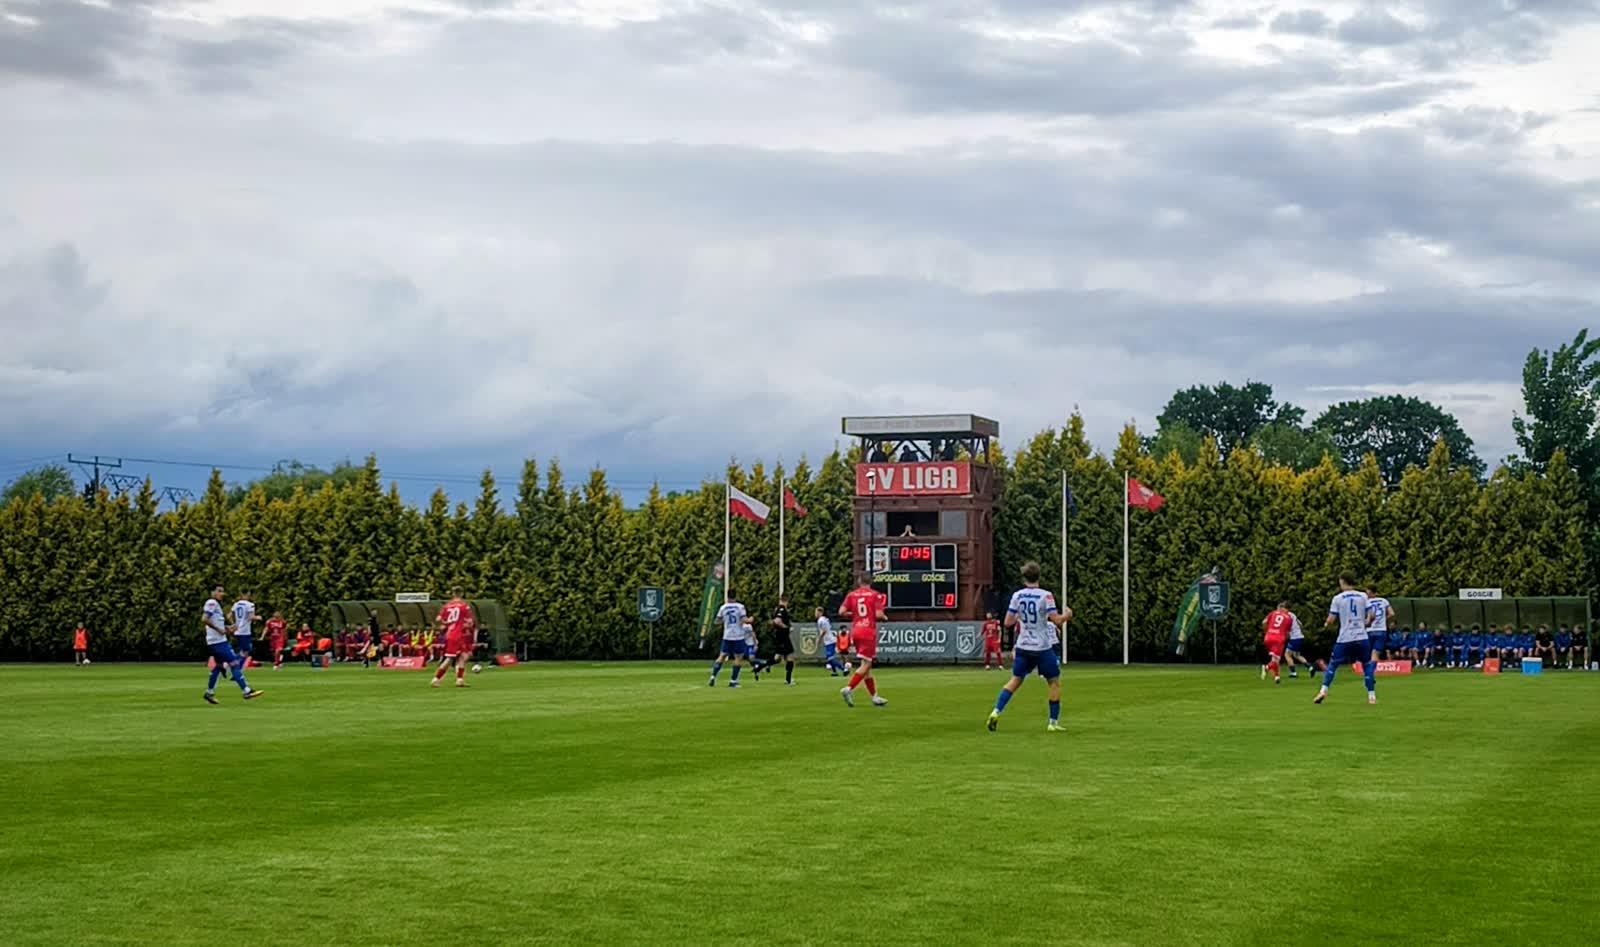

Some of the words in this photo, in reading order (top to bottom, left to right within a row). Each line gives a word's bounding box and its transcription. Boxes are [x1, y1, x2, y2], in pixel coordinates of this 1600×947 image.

[868, 467, 894, 491] IV
[902, 466, 958, 490] LIGA
[900, 547, 931, 560] 0:45
[857, 597, 867, 617] 6
[945, 594, 954, 606] 0
[1350, 598, 1358, 616] 4
[447, 607, 460, 623] 20
[1019, 600, 1038, 624] 39
[1273, 615, 1284, 628] 9
[878, 627, 946, 644] ŻMIGRÓD
